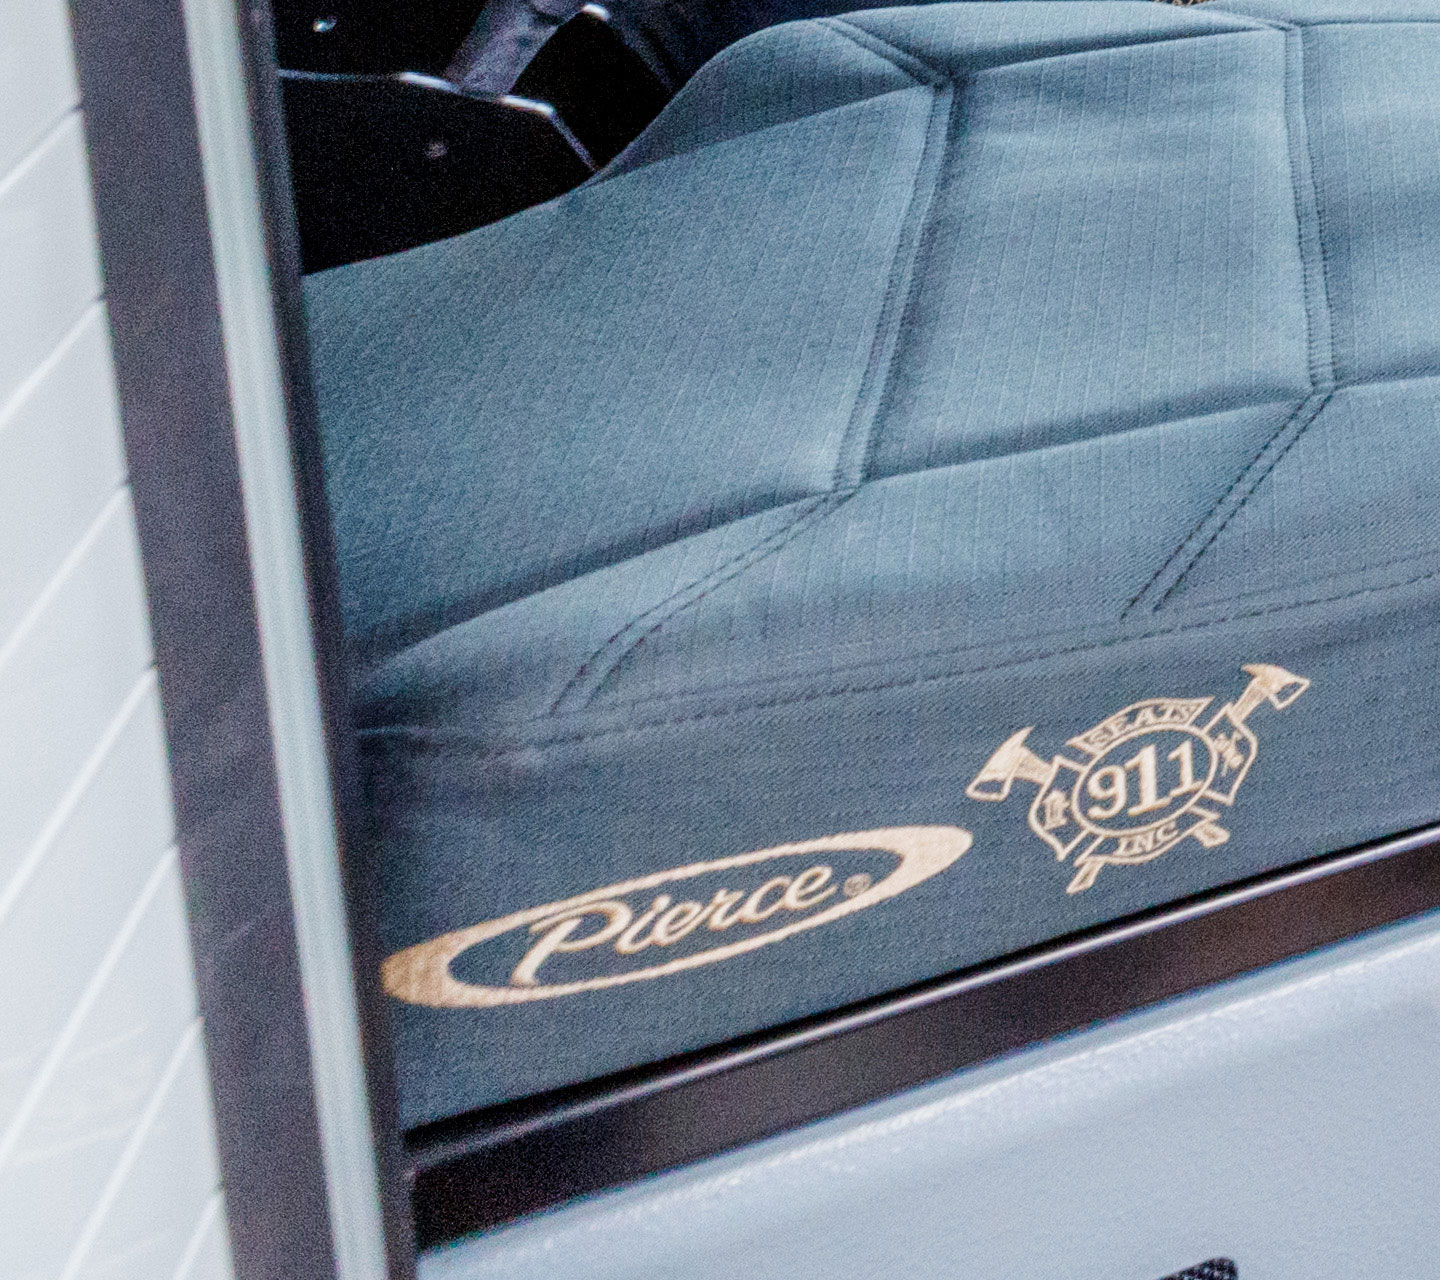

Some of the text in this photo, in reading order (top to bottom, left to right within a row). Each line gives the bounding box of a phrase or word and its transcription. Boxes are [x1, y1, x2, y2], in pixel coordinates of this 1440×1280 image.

[1087, 704, 1196, 747] SEATS
[1086, 740, 1204, 820] 911
[1114, 822, 1179, 857] INC
[510, 865, 836, 987] Pierce
